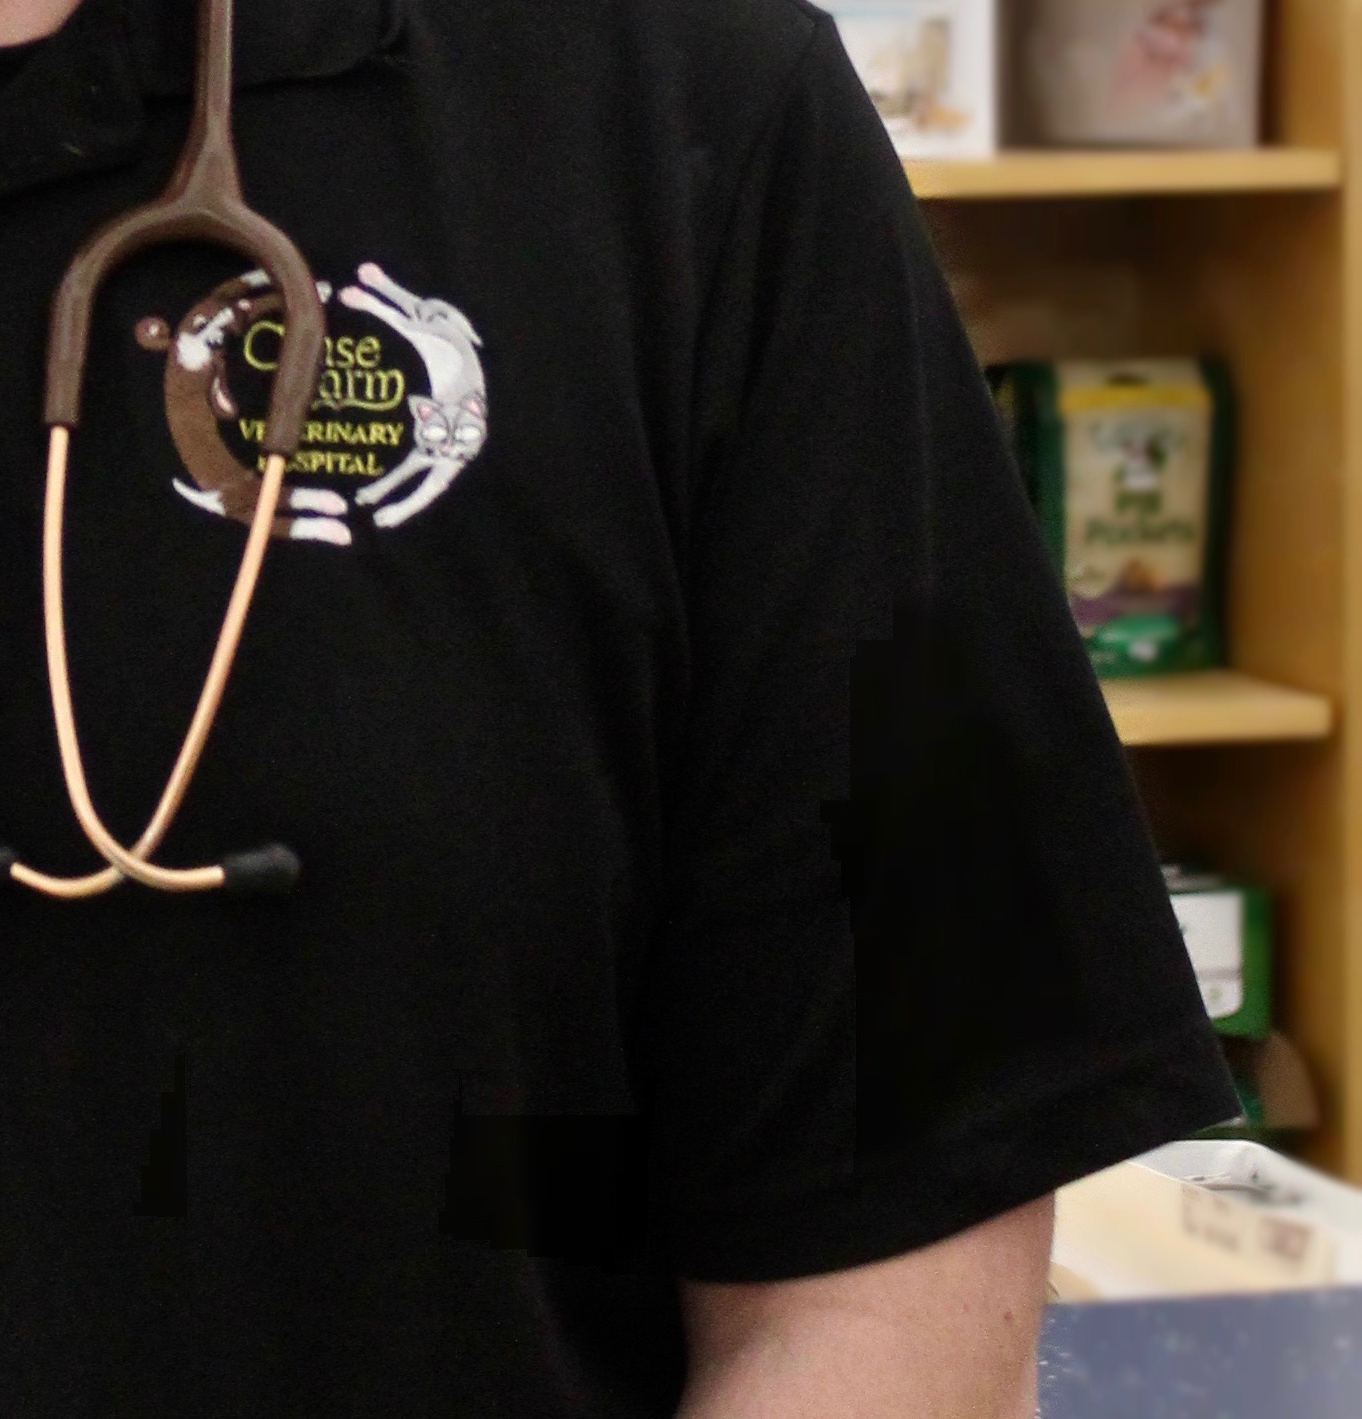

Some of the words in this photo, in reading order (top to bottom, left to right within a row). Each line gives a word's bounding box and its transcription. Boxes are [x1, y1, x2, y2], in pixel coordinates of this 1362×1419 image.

[243, 320, 381, 372] Cse
[311, 368, 406, 411] arm
[240, 417, 404, 445] VERINARY
[257, 450, 383, 476] SPITAL
